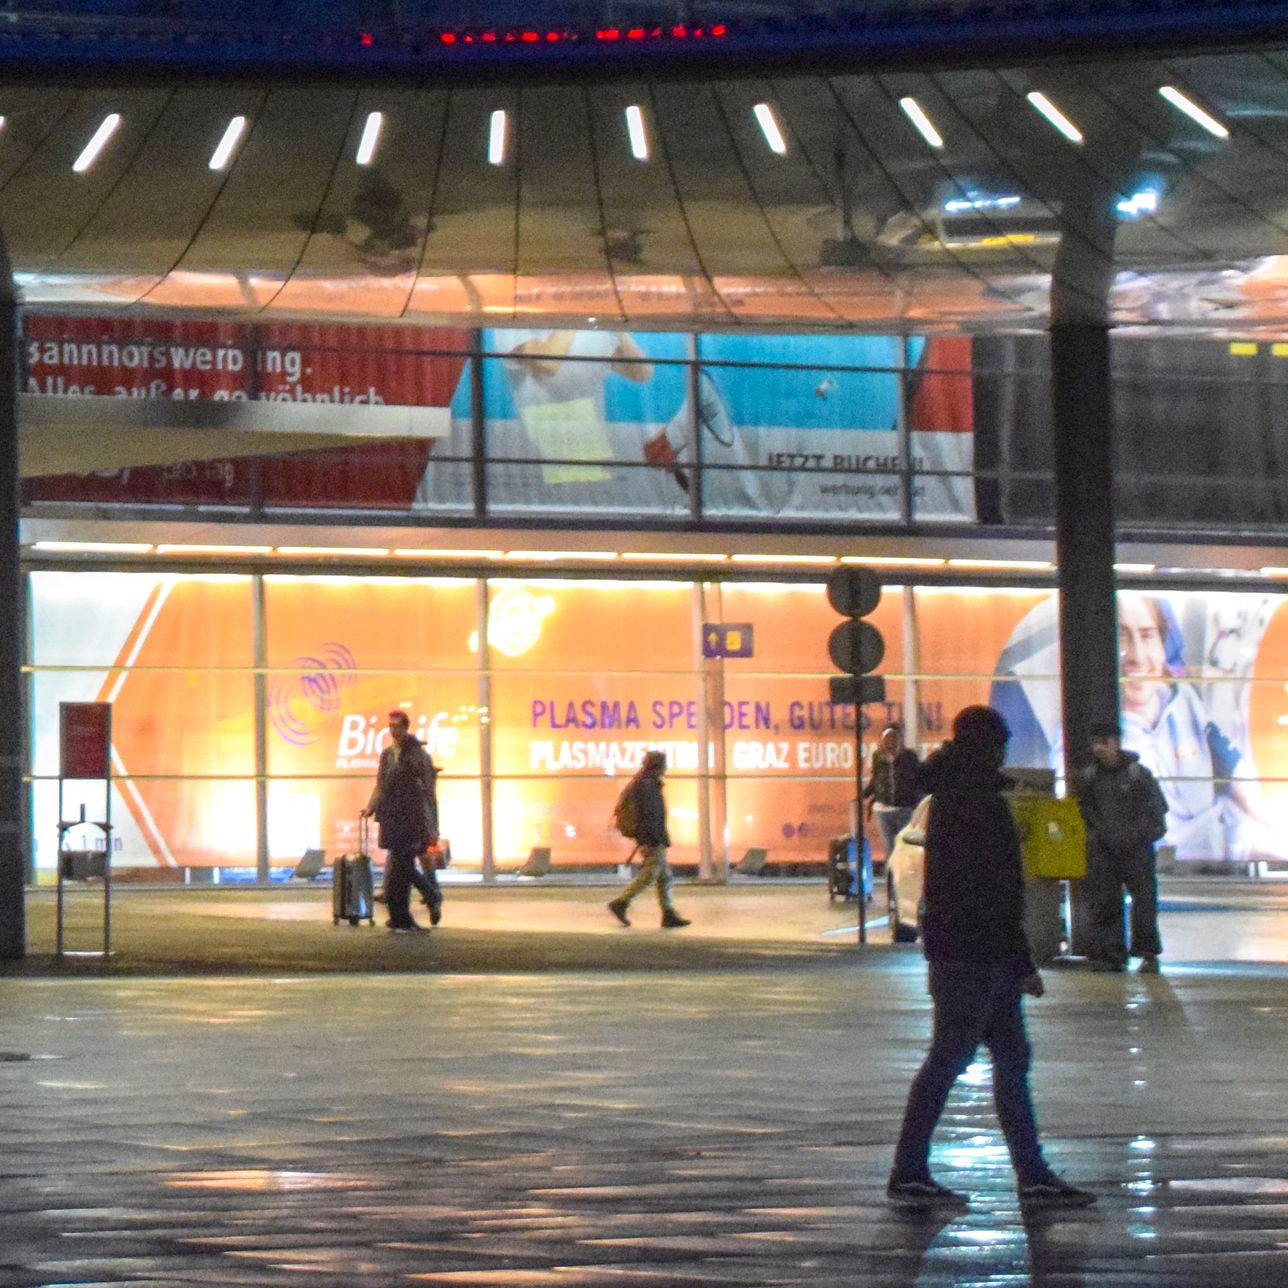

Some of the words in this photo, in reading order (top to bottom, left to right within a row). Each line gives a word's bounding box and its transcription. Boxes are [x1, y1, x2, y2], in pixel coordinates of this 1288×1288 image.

[531, 699, 641, 730] PLASMA
[652, 700, 780, 734] SPEDEN,
[337, 712, 457, 758] Bioife
[733, 741, 790, 769] GRAZ
